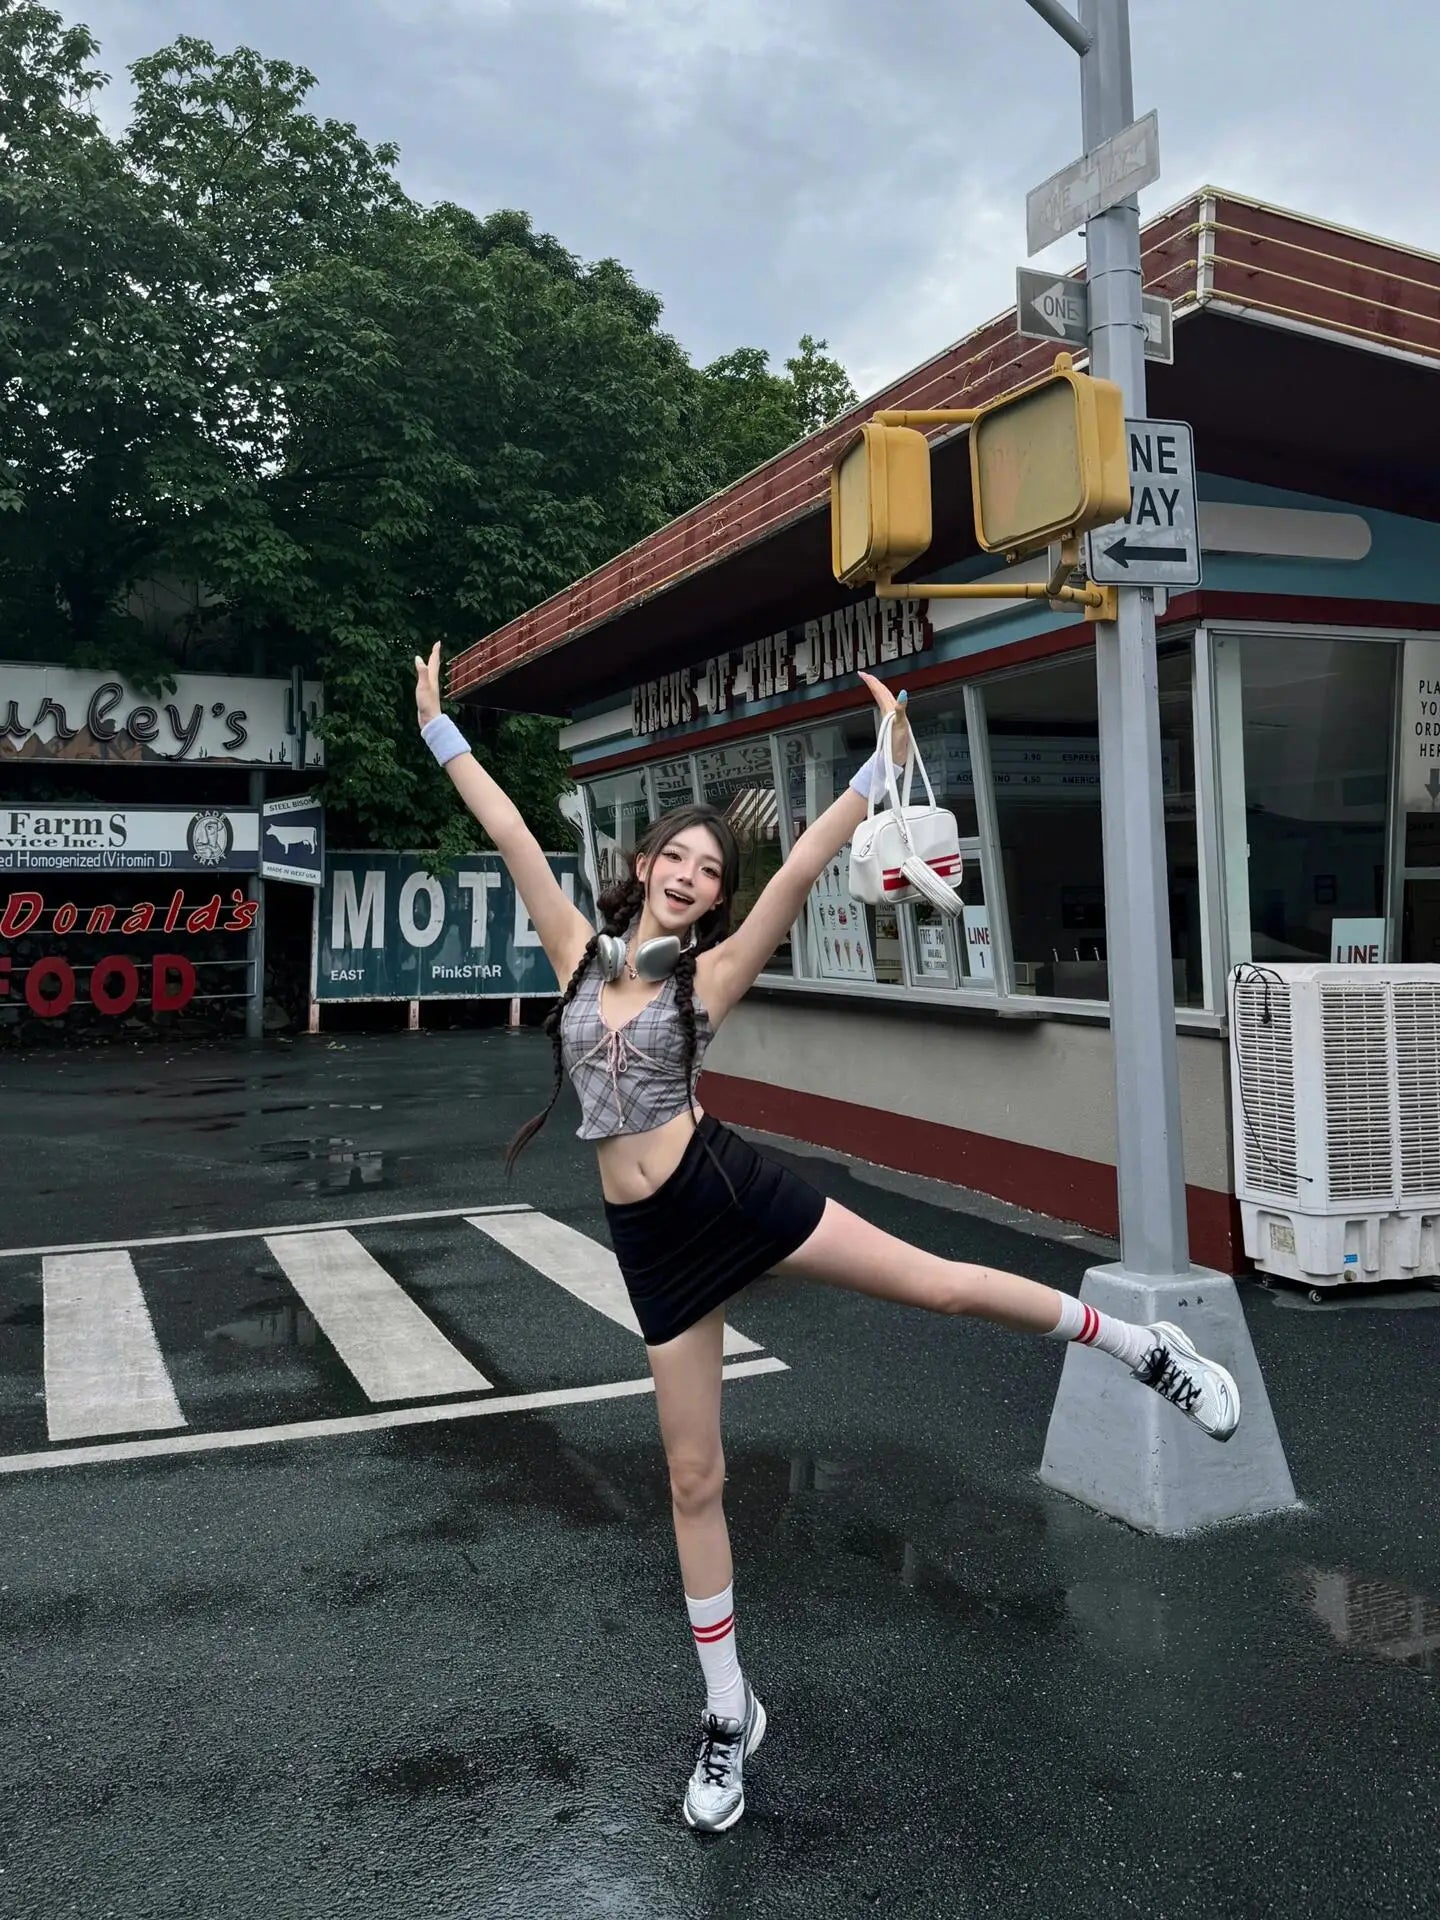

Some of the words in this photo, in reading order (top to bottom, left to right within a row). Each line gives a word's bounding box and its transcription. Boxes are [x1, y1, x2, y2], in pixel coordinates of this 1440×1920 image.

[1043, 295, 1079, 321] ONE
[1130, 434, 1178, 475] NE
[631, 667, 693, 736] CIRCUS
[705, 652, 732, 715] OF
[745, 630, 790, 702] THE
[806, 597, 924, 685] DINNER
[194, 810, 226, 822] MADE
[269, 802, 291, 812] STEEL
[63, 835, 105, 848] Inc.
[17, 851, 101, 869] Homogenized
[159, 851, 173, 868] D)
[192, 853, 227, 866] CRAFT
[290, 869, 305, 877] WEST
[0, 889, 259, 938] Donald's
[968, 927, 990, 946] LINE
[978, 951, 986, 969] 1
[1337, 944, 1379, 964] LINE
[331, 969, 365, 981] EAST
[431, 964, 502, 979] PinkSTAR
